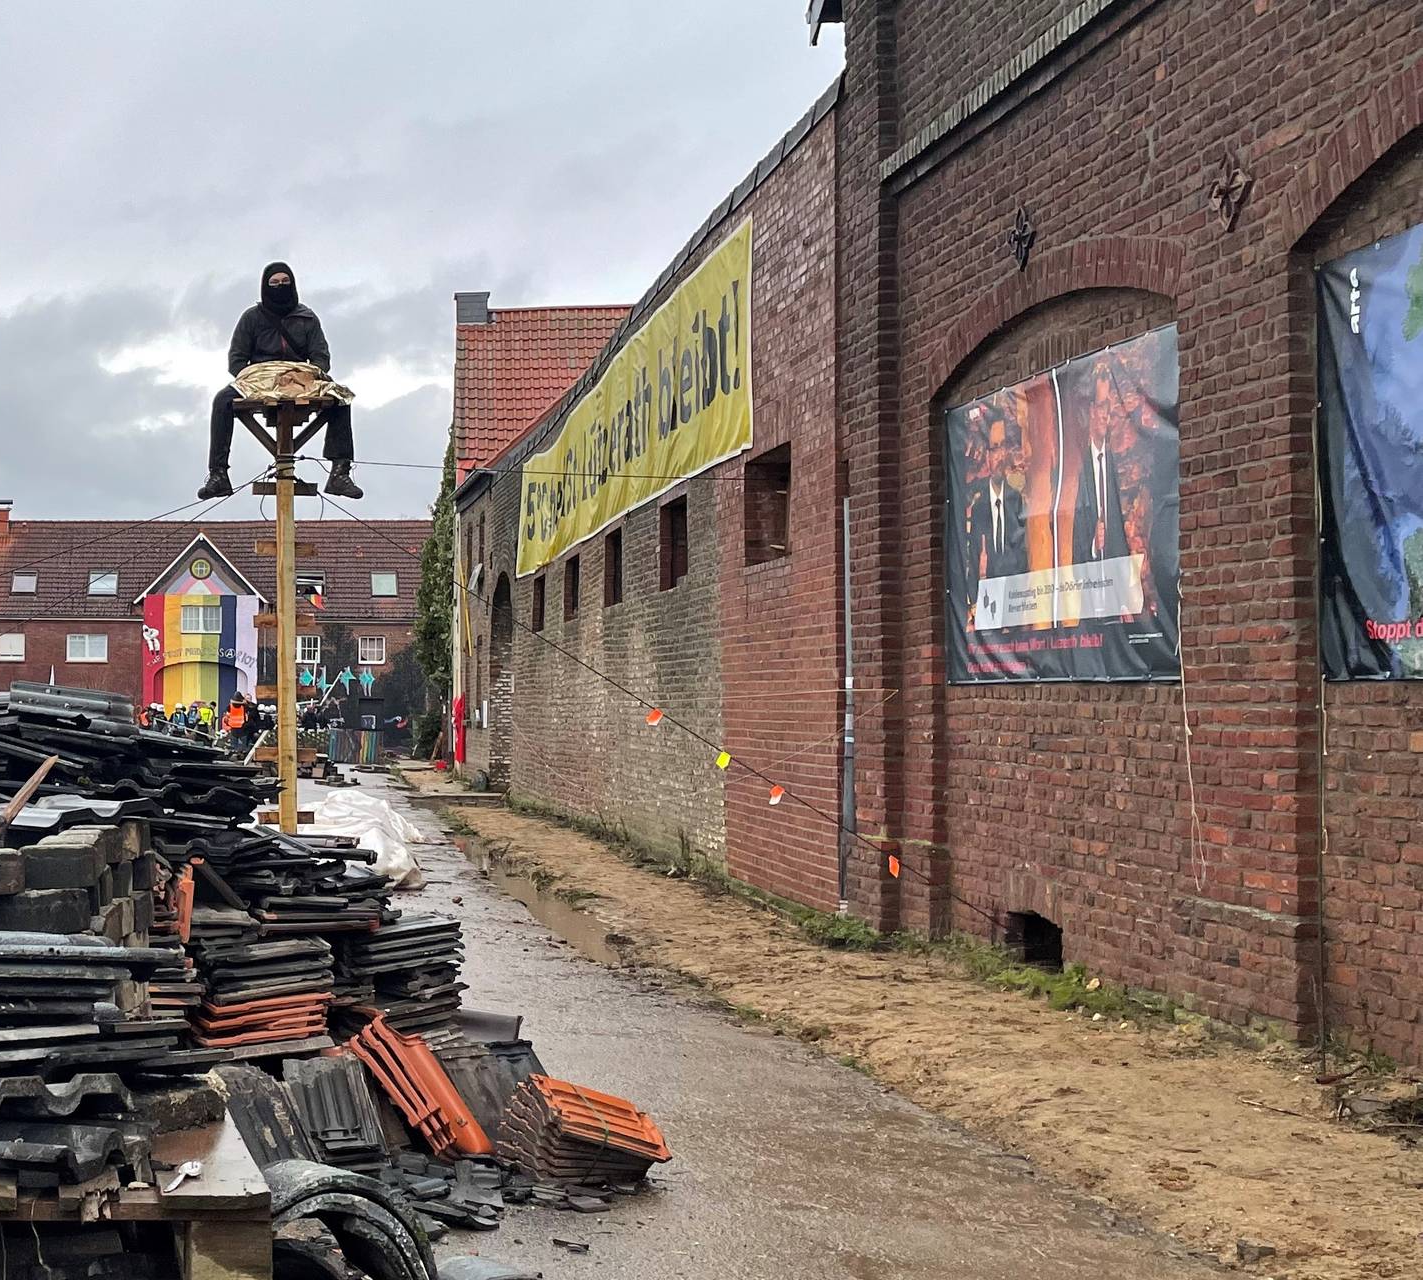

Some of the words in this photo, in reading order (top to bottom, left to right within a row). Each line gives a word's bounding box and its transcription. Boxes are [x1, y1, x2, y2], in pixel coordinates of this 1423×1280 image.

[1350, 267, 1361, 334] arte
[659, 280, 740, 441] bleibt!
[1366, 619, 1412, 644] Stoppt
